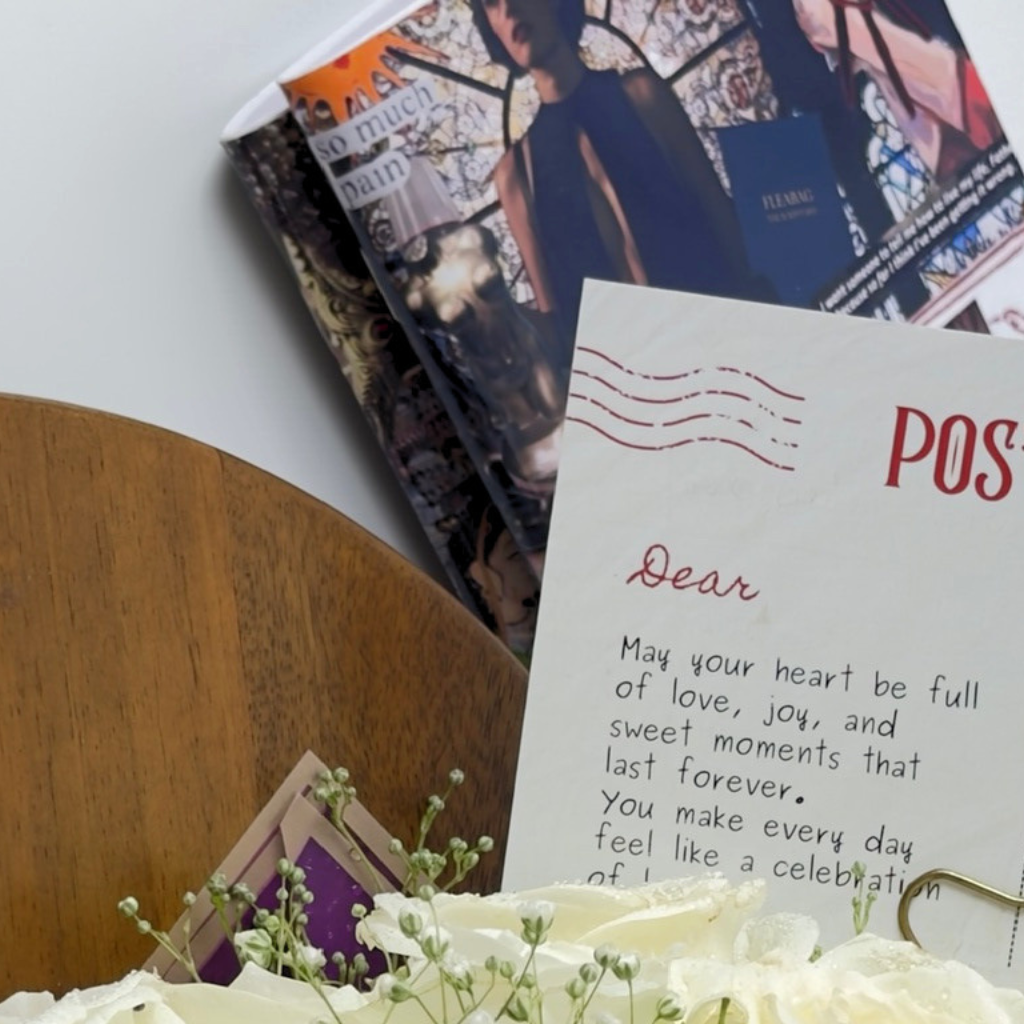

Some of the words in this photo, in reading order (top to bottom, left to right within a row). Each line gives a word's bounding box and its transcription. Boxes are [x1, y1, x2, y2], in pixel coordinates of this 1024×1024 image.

[316, 135, 347, 160] so
[355, 84, 434, 143] much
[341, 158, 405, 210] pain
[846, 256, 880, 292] someone
[879, 246, 891, 261] to
[915, 208, 935, 229] how
[932, 200, 945, 215] to
[626, 543, 760, 601] Dear
[620, 635, 671, 672] May
[691, 652, 755, 677] your
[775, 657, 853, 692] heart
[874, 671, 907, 699] be
[929, 675, 979, 709] full
[615, 671, 652, 699] of
[672, 677, 741, 718] love,
[763, 695, 821, 731] joy,
[844, 709, 898, 739] and
[605, 746, 656, 780] last
[678, 756, 804, 805] forever.
[609, 718, 693, 747] sweet
[713, 732, 841, 770] moments
[863, 745, 921, 780] that
[595, 821, 653, 857] feel
[674, 833, 720, 868] like
[740, 855, 755, 873] a
[773, 853, 941, 901] celebatin
[675, 805, 744, 832] make
[763, 819, 844, 854] every
[864, 825, 914, 864] day
